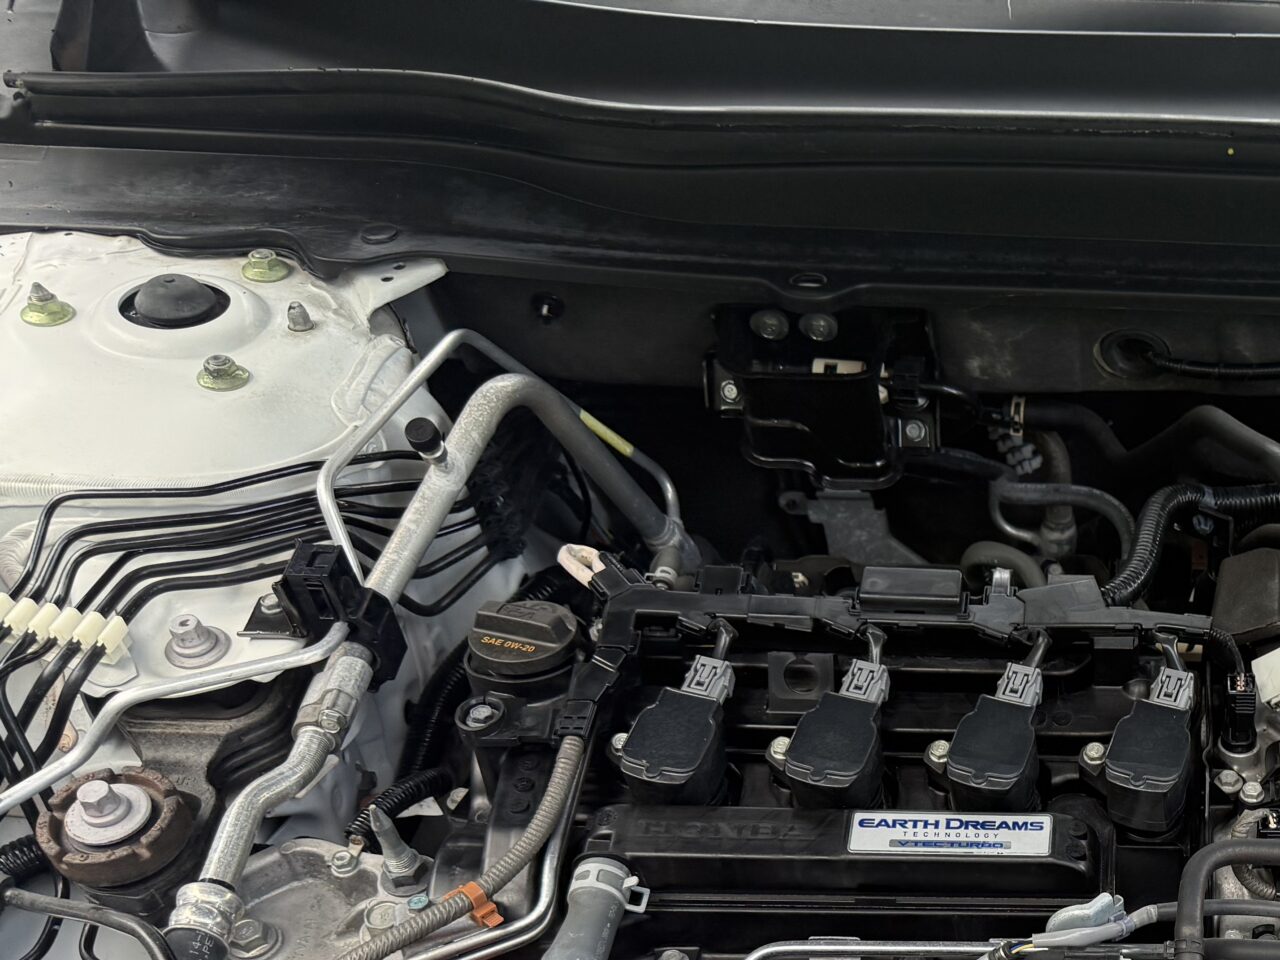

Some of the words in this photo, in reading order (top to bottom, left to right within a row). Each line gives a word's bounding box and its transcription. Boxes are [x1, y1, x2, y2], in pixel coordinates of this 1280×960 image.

[481, 636, 505, 646] SAE
[503, 641, 536, 653] 0W-20
[857, 818, 940, 830] EARTH
[944, 818, 1045, 832] DREAMS
[903, 831, 1000, 839] TECHNOLOGY
